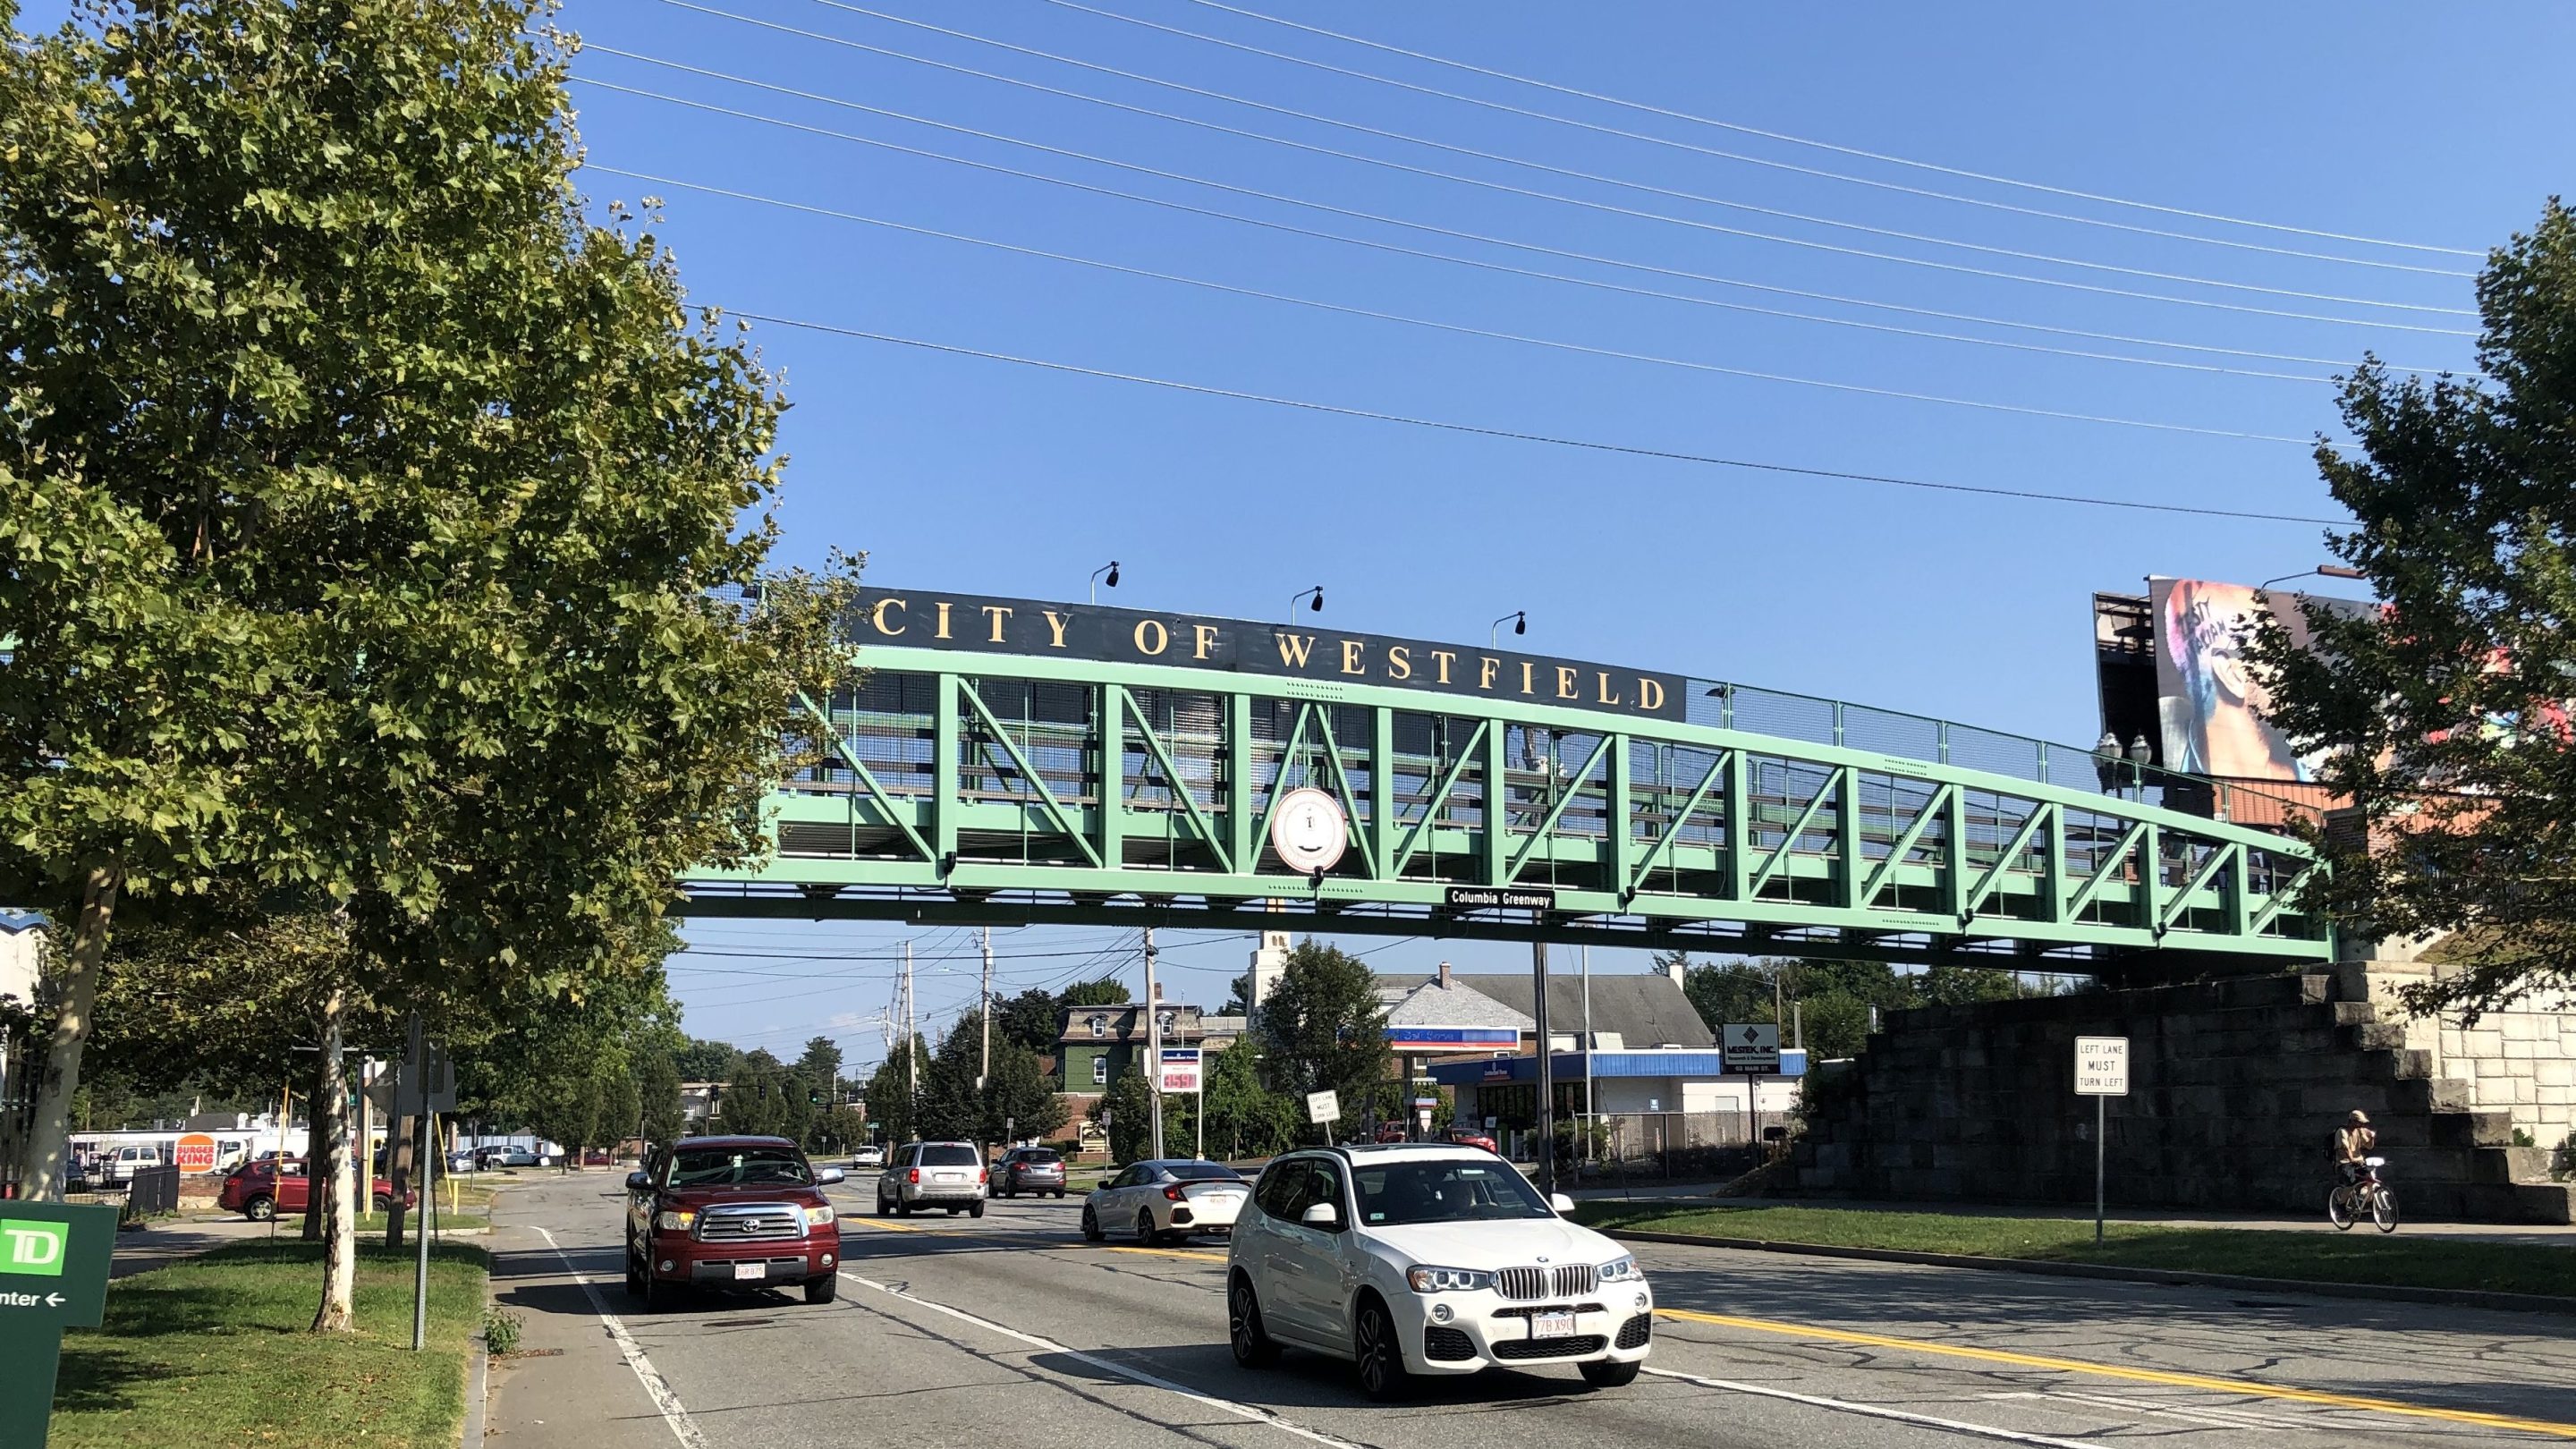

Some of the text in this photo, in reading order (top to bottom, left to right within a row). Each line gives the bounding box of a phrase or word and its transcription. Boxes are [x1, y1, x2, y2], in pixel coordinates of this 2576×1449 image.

[872, 597, 1666, 710] CITY OF WESTFIELD
[1452, 890, 1550, 909] Columbia Greenway
[2080, 1044, 2123, 1055] LEFT LANE
[2088, 1060, 2115, 1072] MUST
[2079, 1077, 2123, 1088] TURN LEFT
[176, 1146, 215, 1154] BURGER
[176, 1153, 215, 1165] KING
[4, 1228, 60, 1265] TD
[0, 1291, 41, 1306] nter
